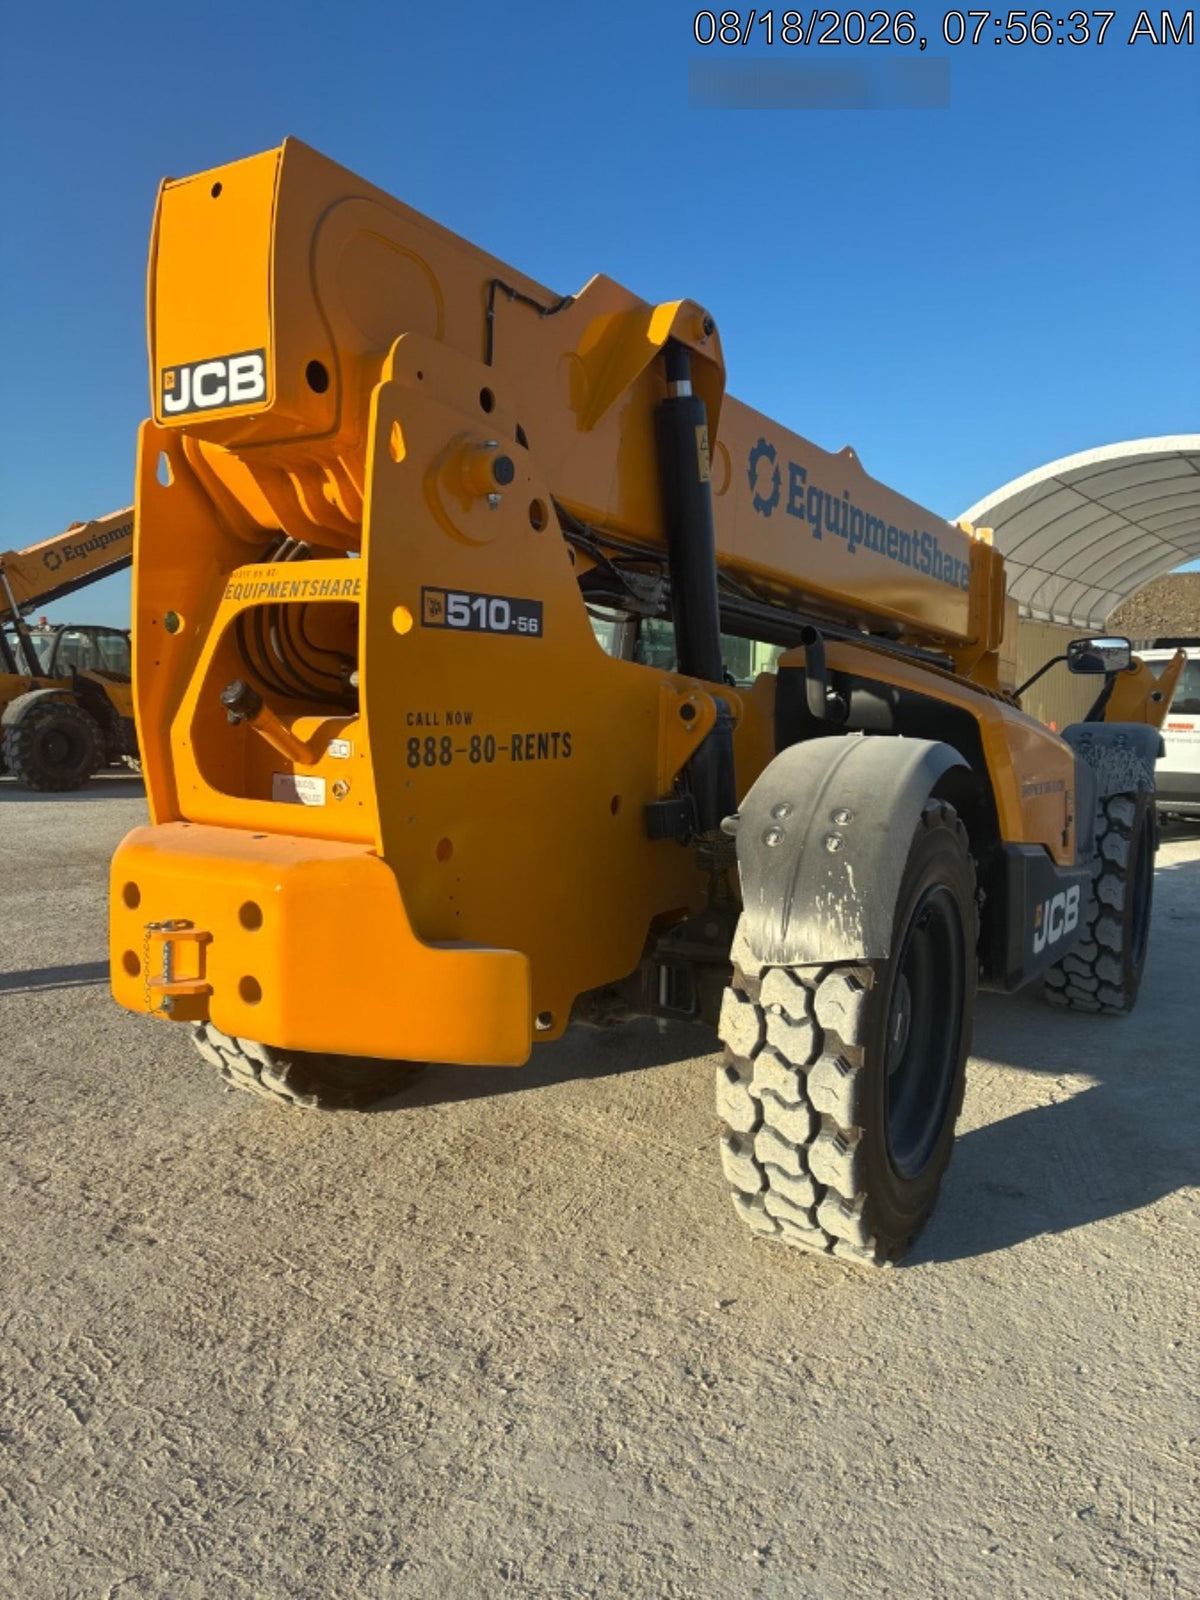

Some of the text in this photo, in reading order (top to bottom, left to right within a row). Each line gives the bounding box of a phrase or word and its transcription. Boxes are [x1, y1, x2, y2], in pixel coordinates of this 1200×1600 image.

[163, 354, 266, 413] JCB
[62, 522, 135, 562] Equipme
[786, 461, 970, 592] EquipmentShare
[224, 578, 361, 602] EQUIPMENTSHARE
[406, 711, 474, 726] CALL NOW
[407, 731, 573, 769] 888-80-RENTS
[1033, 884, 1080, 954] JCB
